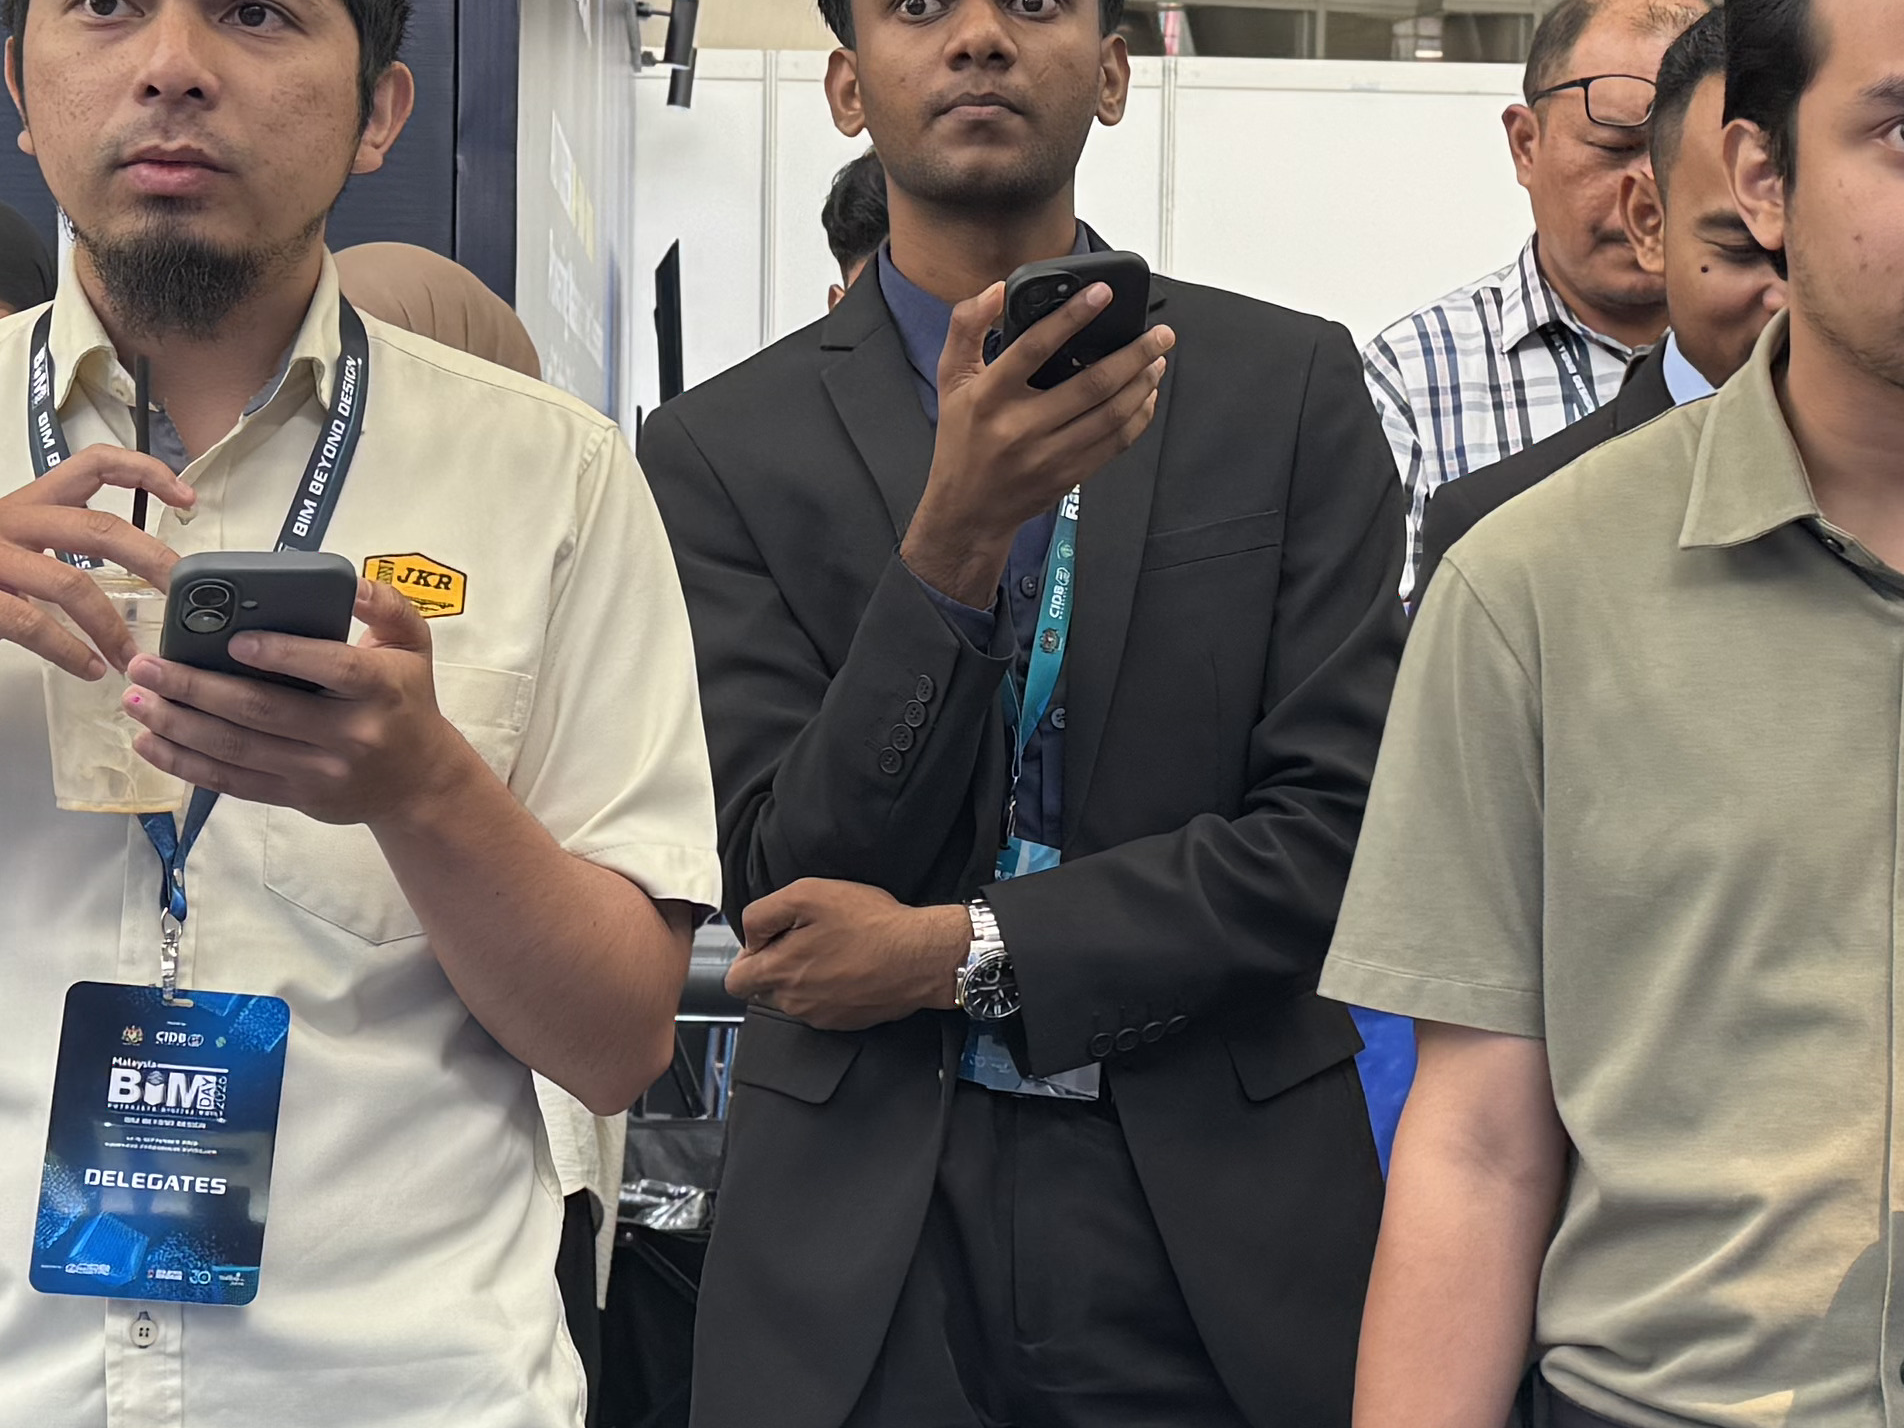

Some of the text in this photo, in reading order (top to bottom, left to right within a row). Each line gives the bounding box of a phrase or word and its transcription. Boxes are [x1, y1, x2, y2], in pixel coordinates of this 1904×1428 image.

[292, 355, 359, 538] BIM BEYOND DESIGN
[397, 566, 453, 591] JKR
[84, 1168, 227, 1195] DELEGATES
